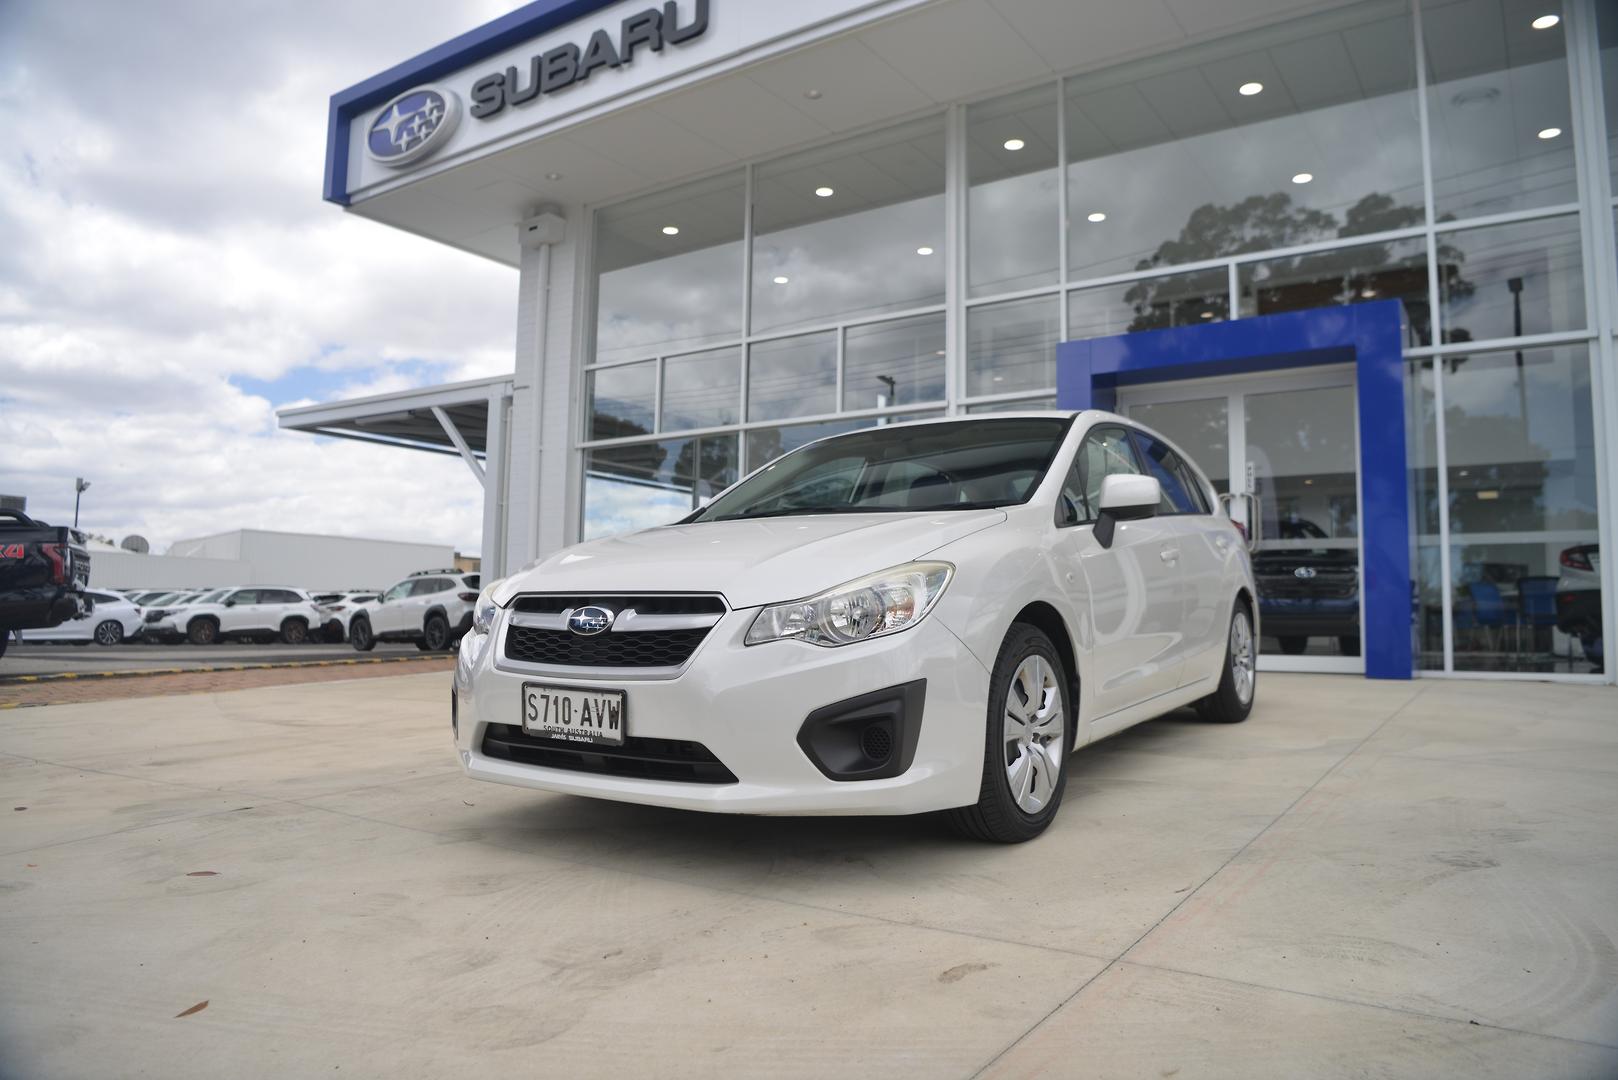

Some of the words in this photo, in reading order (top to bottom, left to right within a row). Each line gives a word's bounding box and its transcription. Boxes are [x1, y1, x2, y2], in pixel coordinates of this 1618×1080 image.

[470, 0, 709, 119] SUBARU
[543, 725, 565, 733] SOUTH
[567, 727, 603, 737] AUSTRALIA
